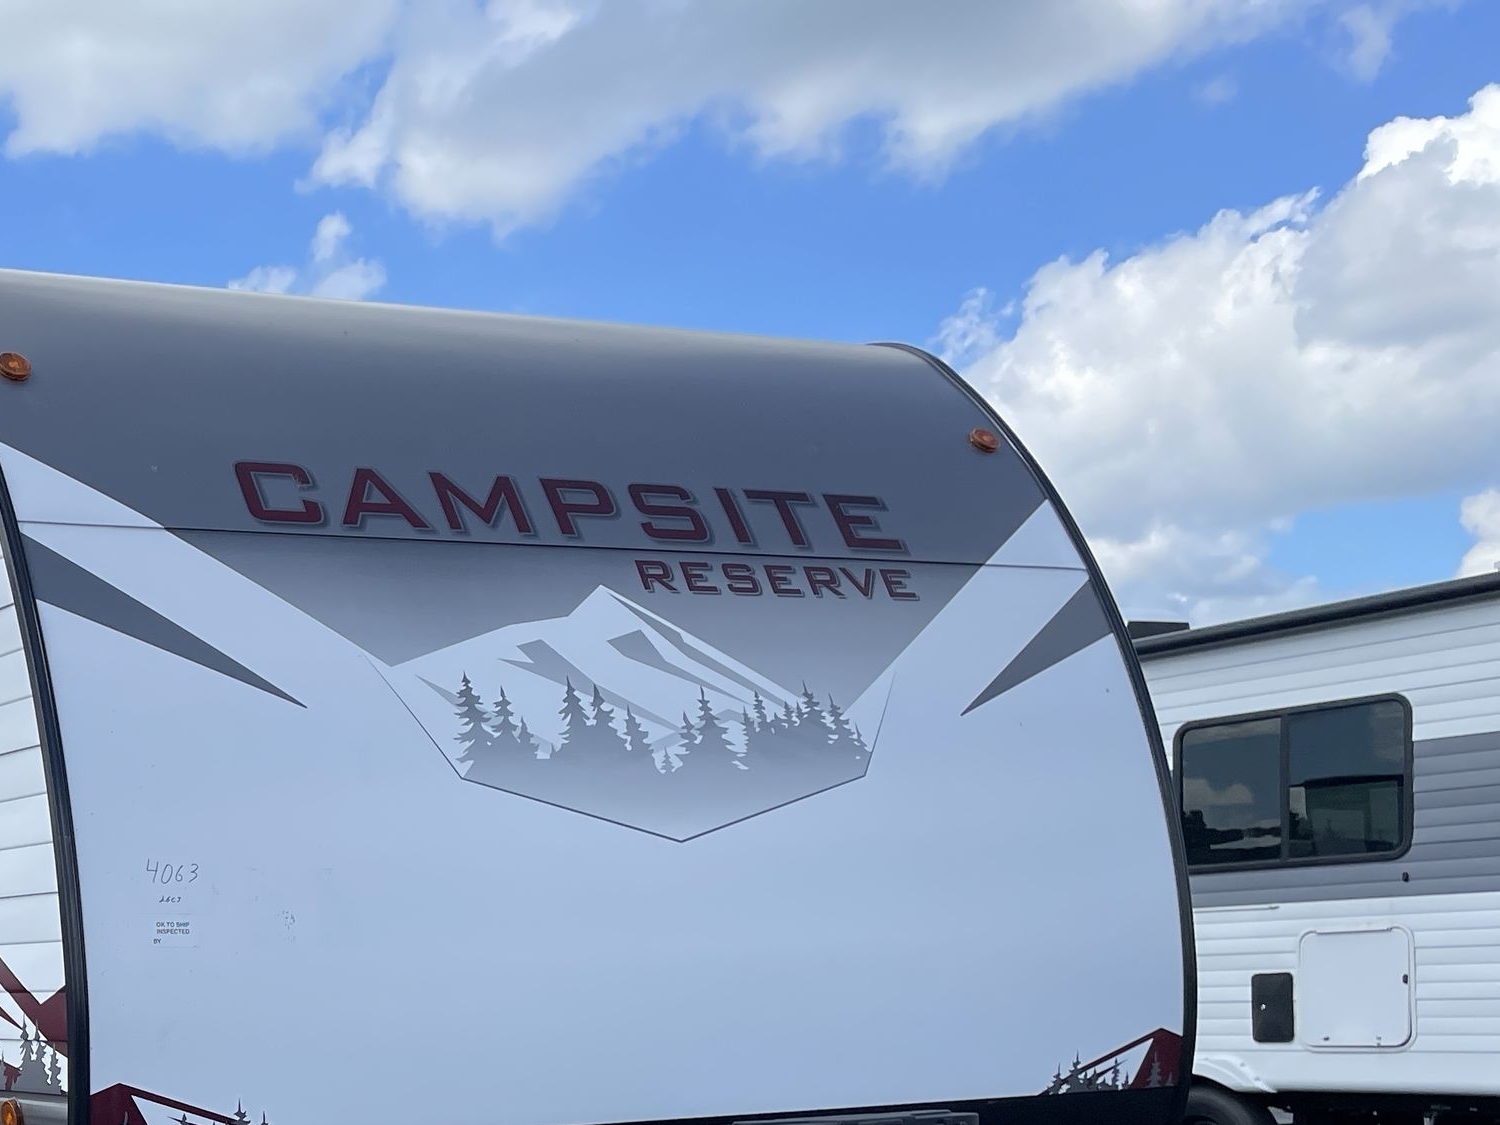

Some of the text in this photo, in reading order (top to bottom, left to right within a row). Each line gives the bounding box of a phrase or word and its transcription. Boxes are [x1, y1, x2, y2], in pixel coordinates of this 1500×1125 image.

[233, 459, 908, 552] CAMPSITE
[634, 559, 920, 602] RESERVE
[146, 858, 199, 885] 4063
